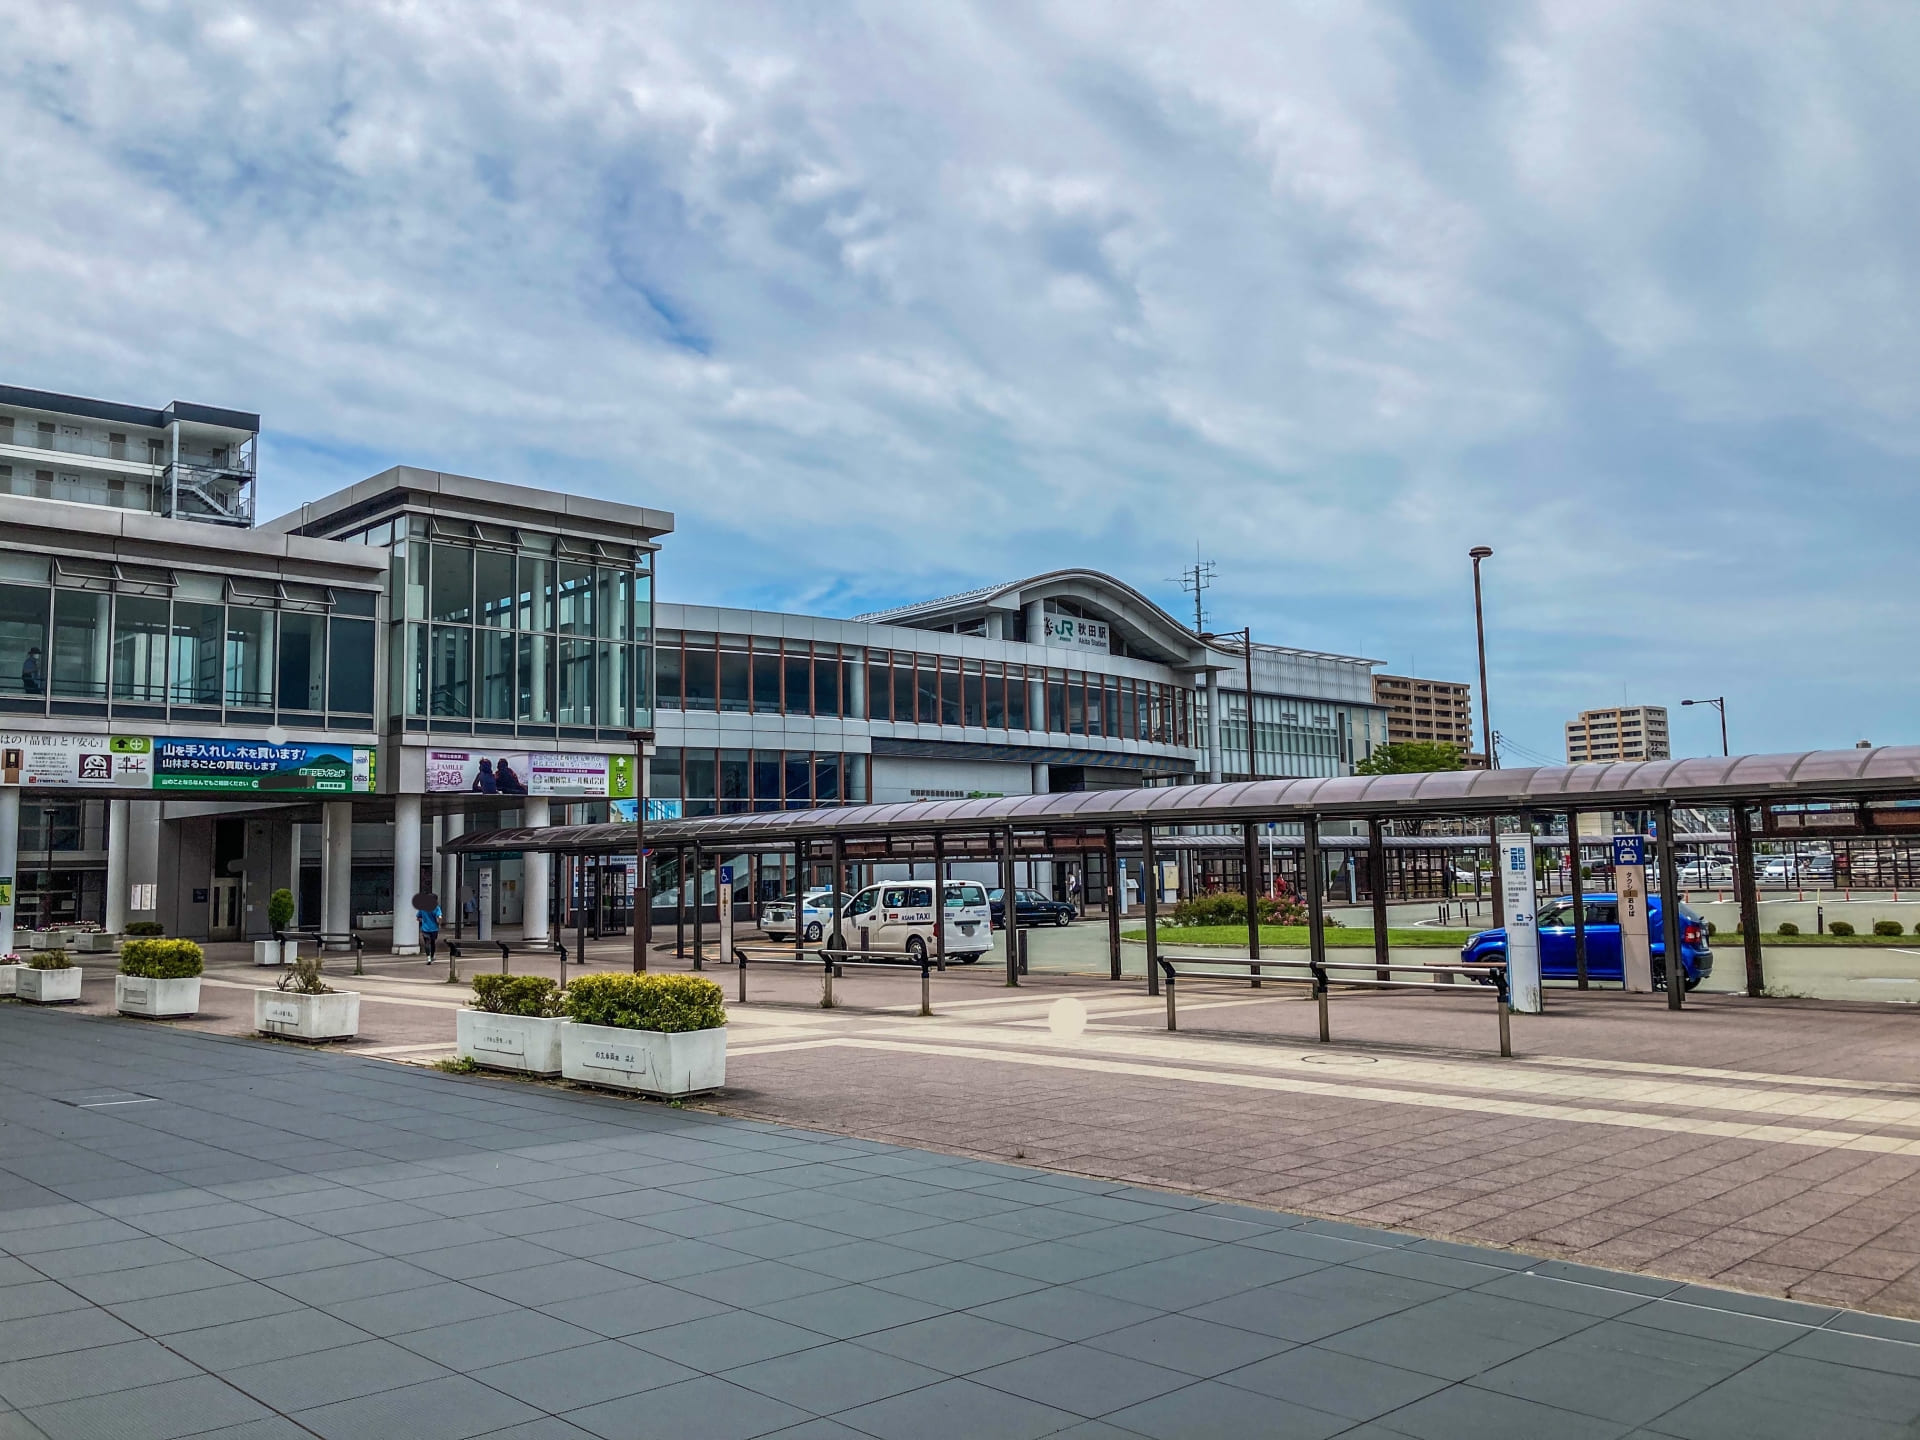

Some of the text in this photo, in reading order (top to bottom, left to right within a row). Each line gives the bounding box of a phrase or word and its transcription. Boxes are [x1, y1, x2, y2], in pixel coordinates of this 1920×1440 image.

[1055, 620, 1073, 637] JR
[1078, 622, 1106, 639] 秋田駅
[162, 758, 277, 771] 山林まるごとの買取もします
[1615, 839, 1639, 847] TAXI
[915, 912, 931, 921] TAXI
